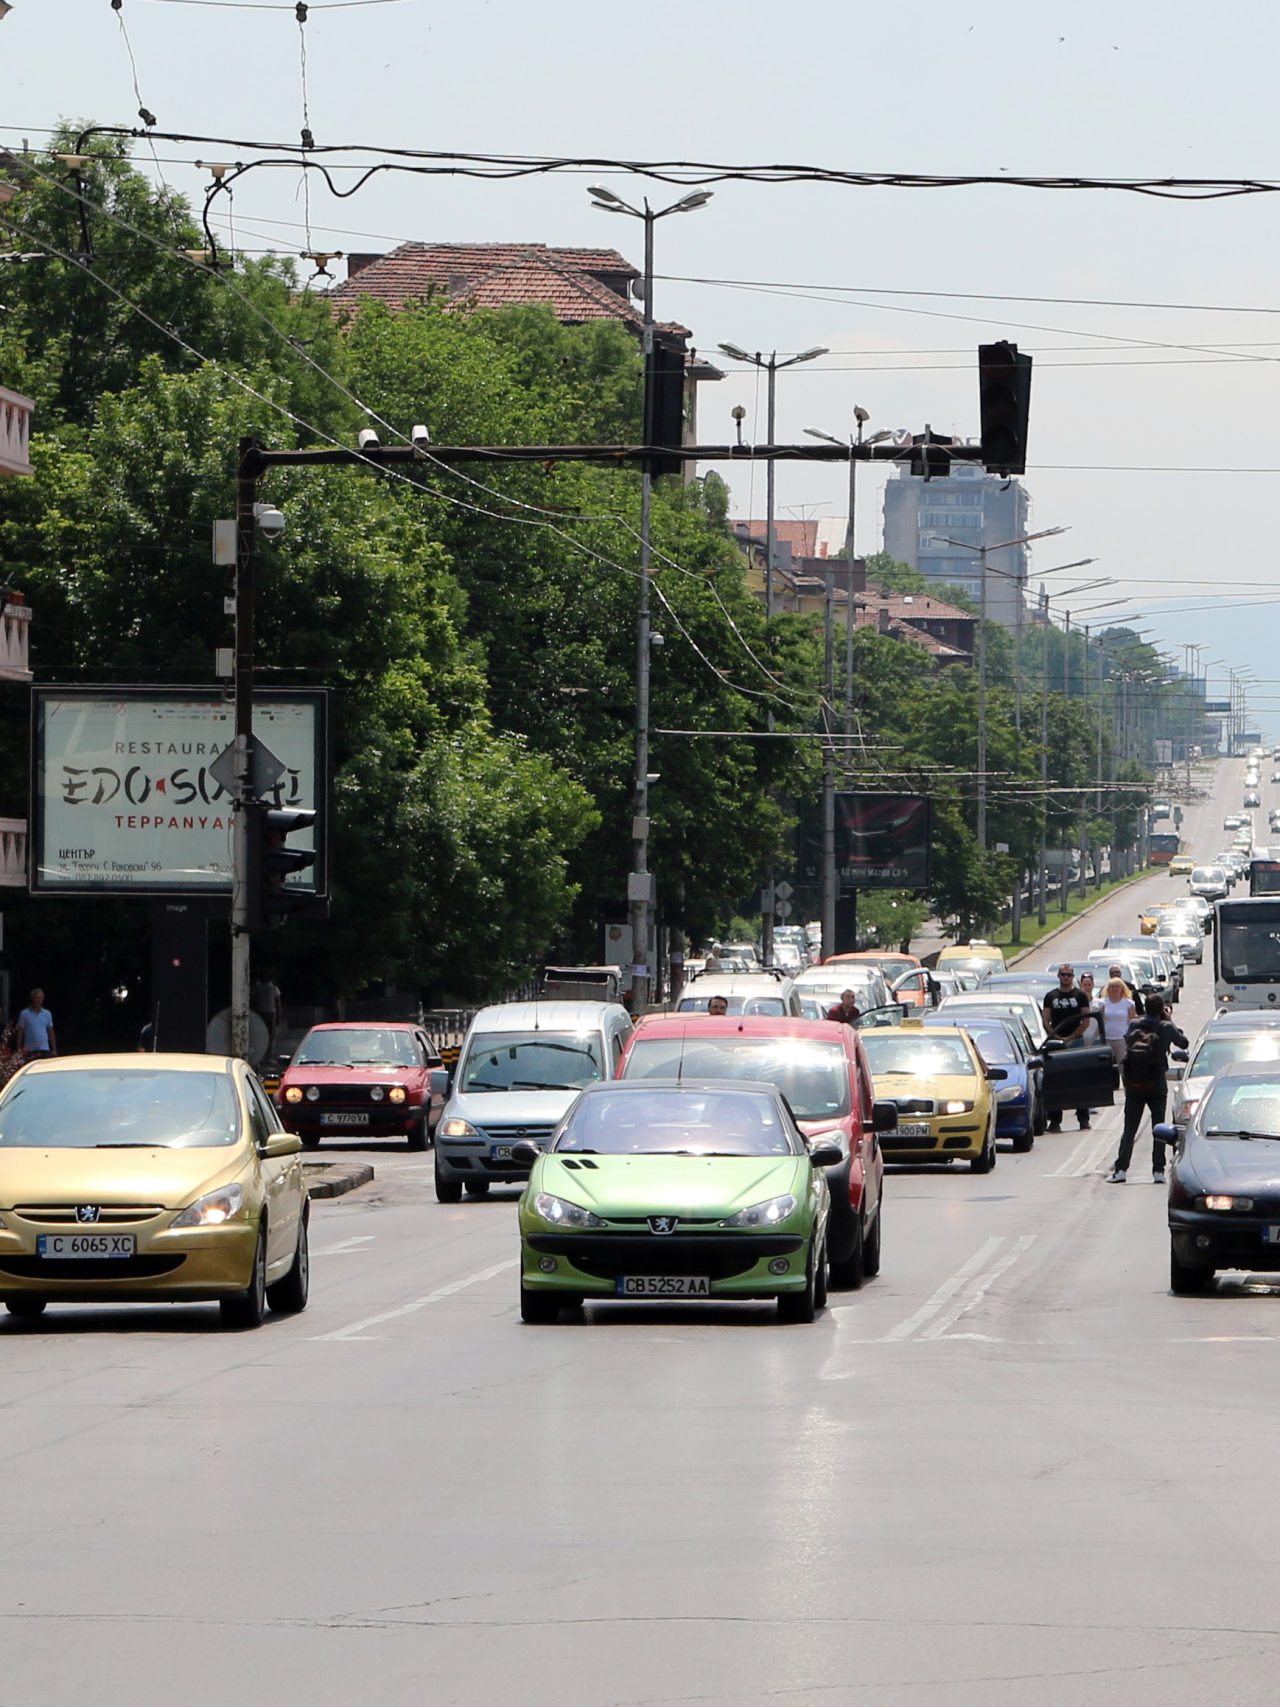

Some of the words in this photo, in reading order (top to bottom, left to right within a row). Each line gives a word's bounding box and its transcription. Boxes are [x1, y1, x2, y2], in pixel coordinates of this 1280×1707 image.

[115, 742, 229, 754] RESTAURA
[62, 766, 151, 805] EDO
[115, 816, 236, 829] TEPPANYAK
[59, 849, 95, 860] ЦЕНТЪР
[895, 1126, 915, 1136] 1900
[53, 1238, 63, 1252] C
[71, 1238, 108, 1252] 6065
[111, 1238, 131, 1252] XC
[625, 1279, 645, 1292] CB
[648, 1279, 685, 1293] 5252
[688, 1279, 707, 1293] AA
